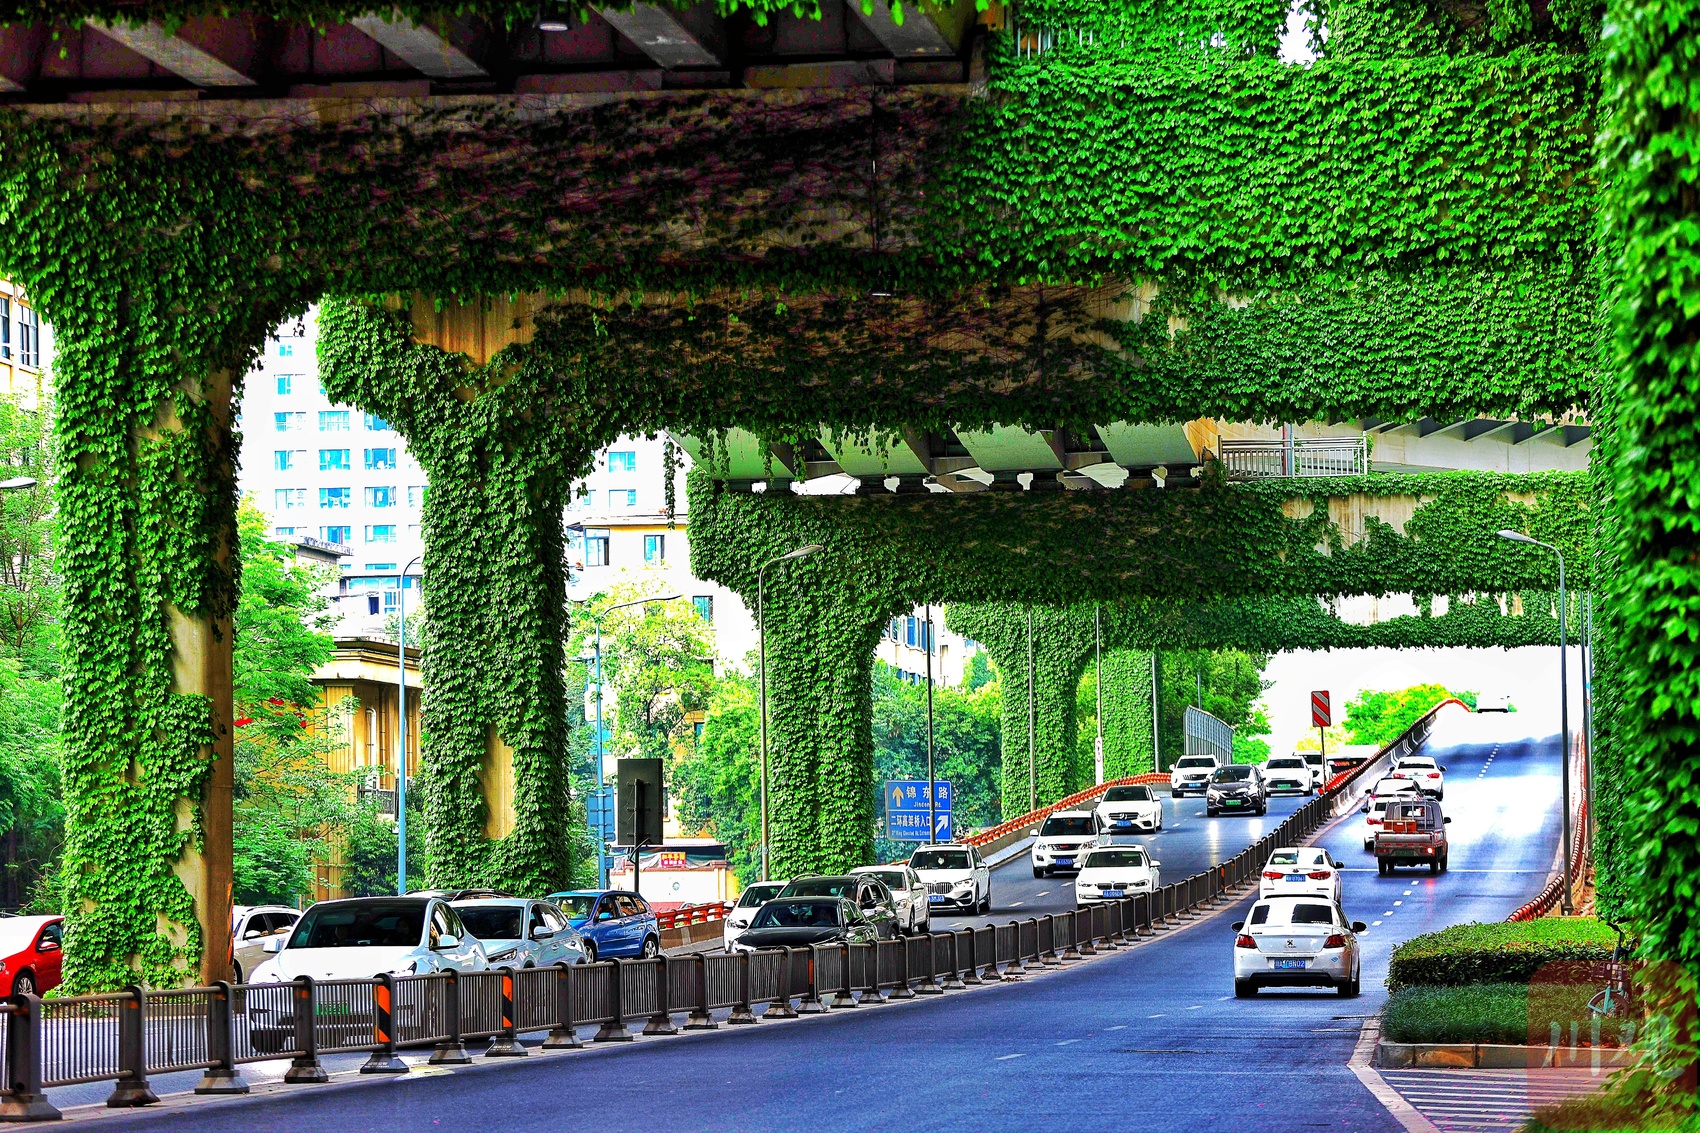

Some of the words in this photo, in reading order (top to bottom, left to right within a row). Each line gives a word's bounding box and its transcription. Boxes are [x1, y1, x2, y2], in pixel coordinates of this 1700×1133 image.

[906, 786, 948, 799] 锦东路
[891, 814, 930, 827] 二环高架桥入口
